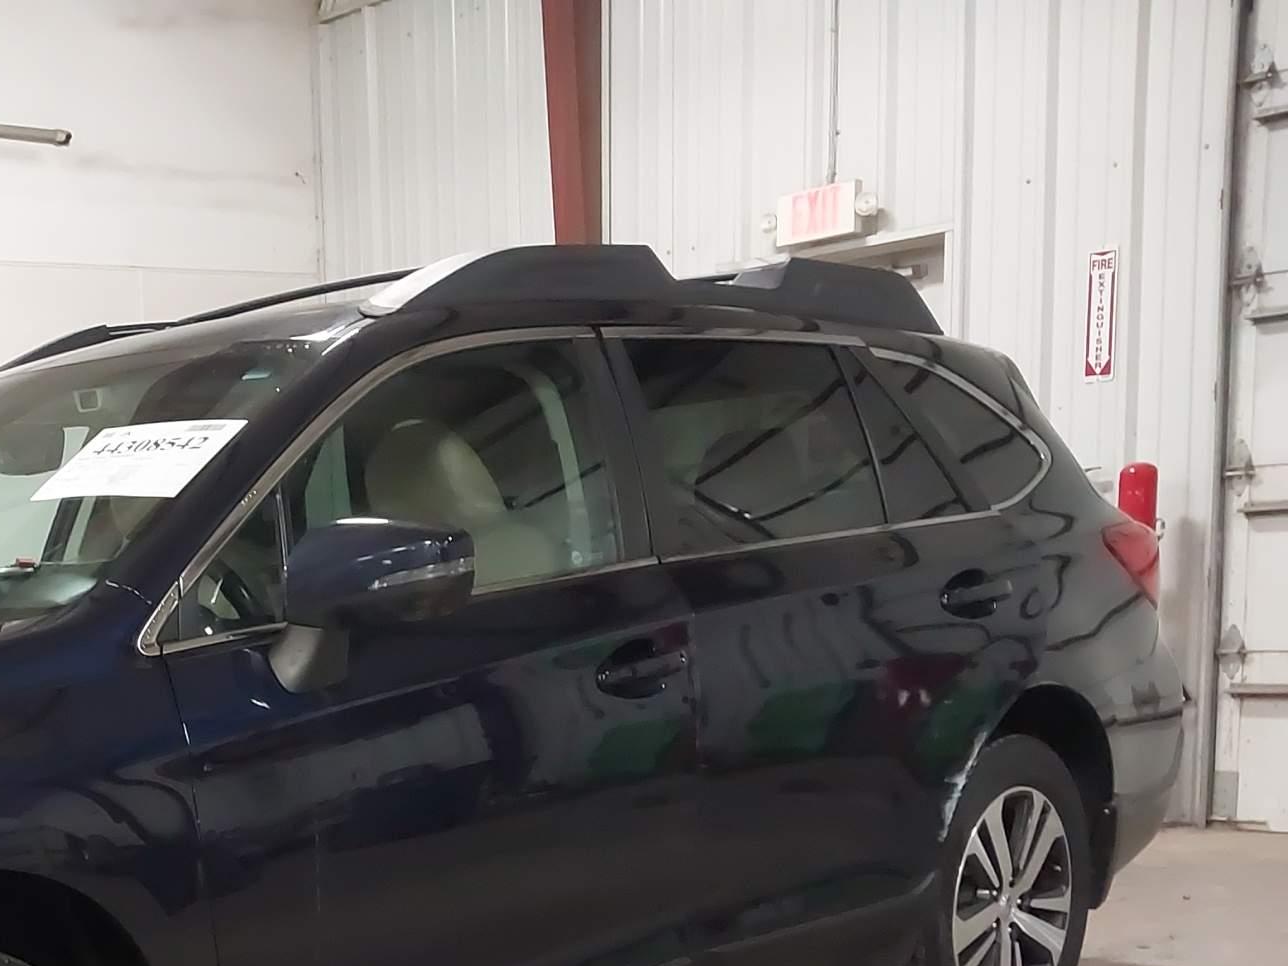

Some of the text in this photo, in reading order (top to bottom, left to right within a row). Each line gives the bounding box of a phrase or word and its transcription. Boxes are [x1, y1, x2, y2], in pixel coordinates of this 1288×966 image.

[792, 186, 840, 238] EXIT
[1092, 258, 1113, 271] FIRE
[1095, 273, 1105, 369] EXTINGUISHER
[93, 436, 209, 455] 44308542
